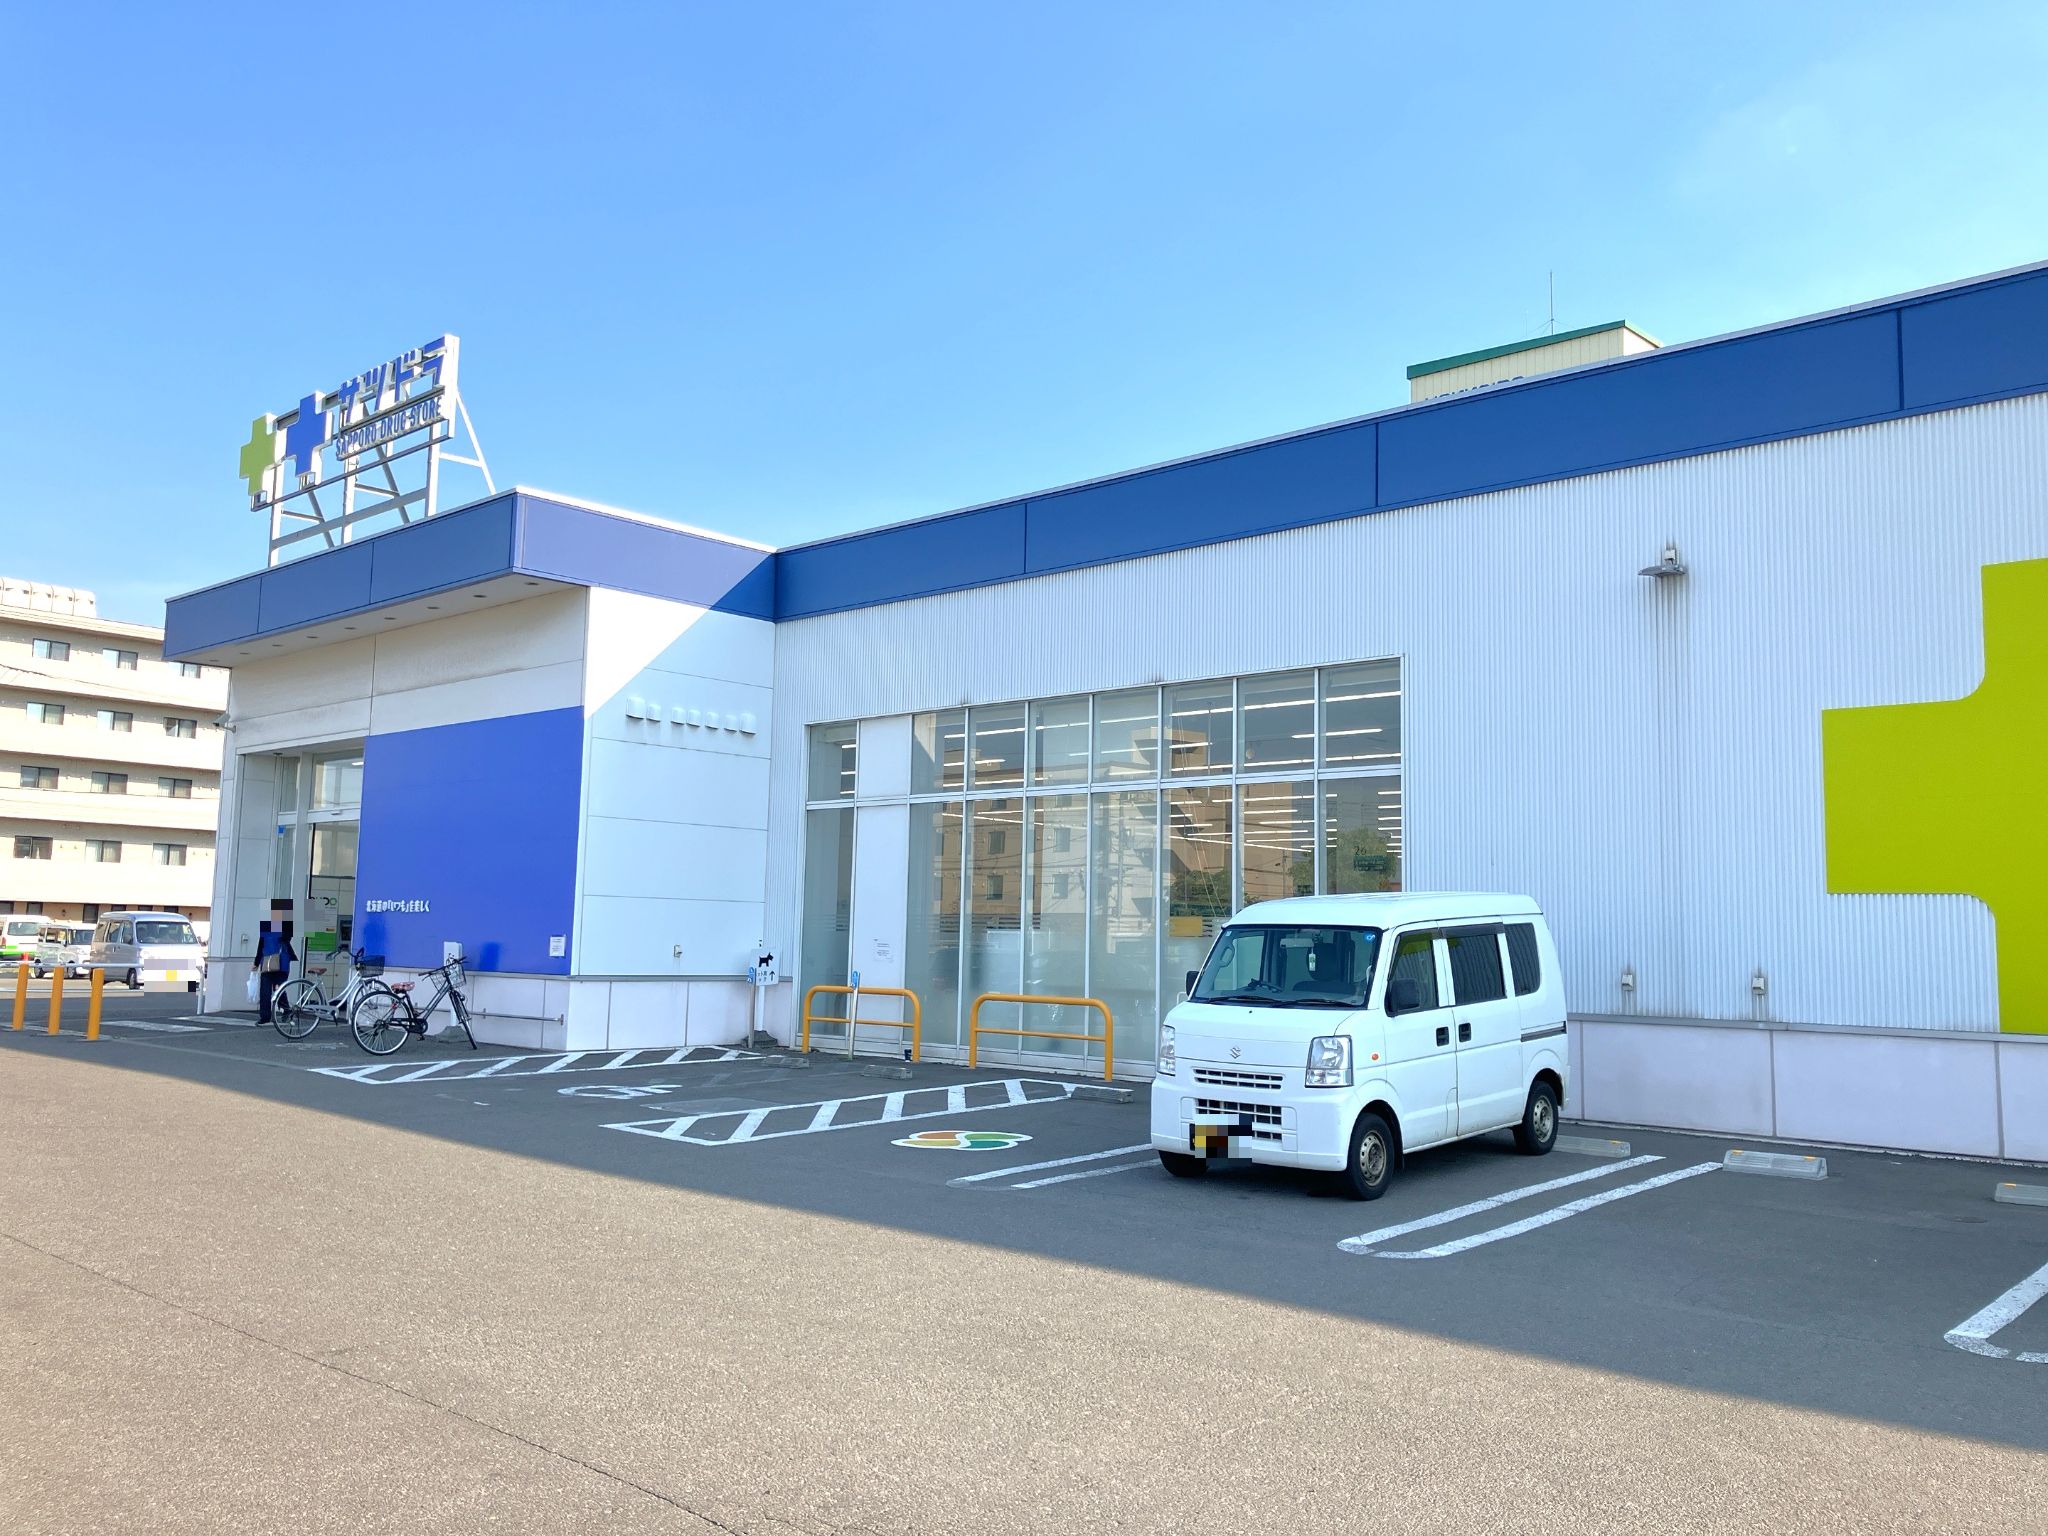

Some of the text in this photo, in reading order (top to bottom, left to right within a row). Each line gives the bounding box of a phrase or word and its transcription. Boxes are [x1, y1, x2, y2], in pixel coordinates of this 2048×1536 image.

[336, 397, 442, 457] SAPPORO DRUG STORE
